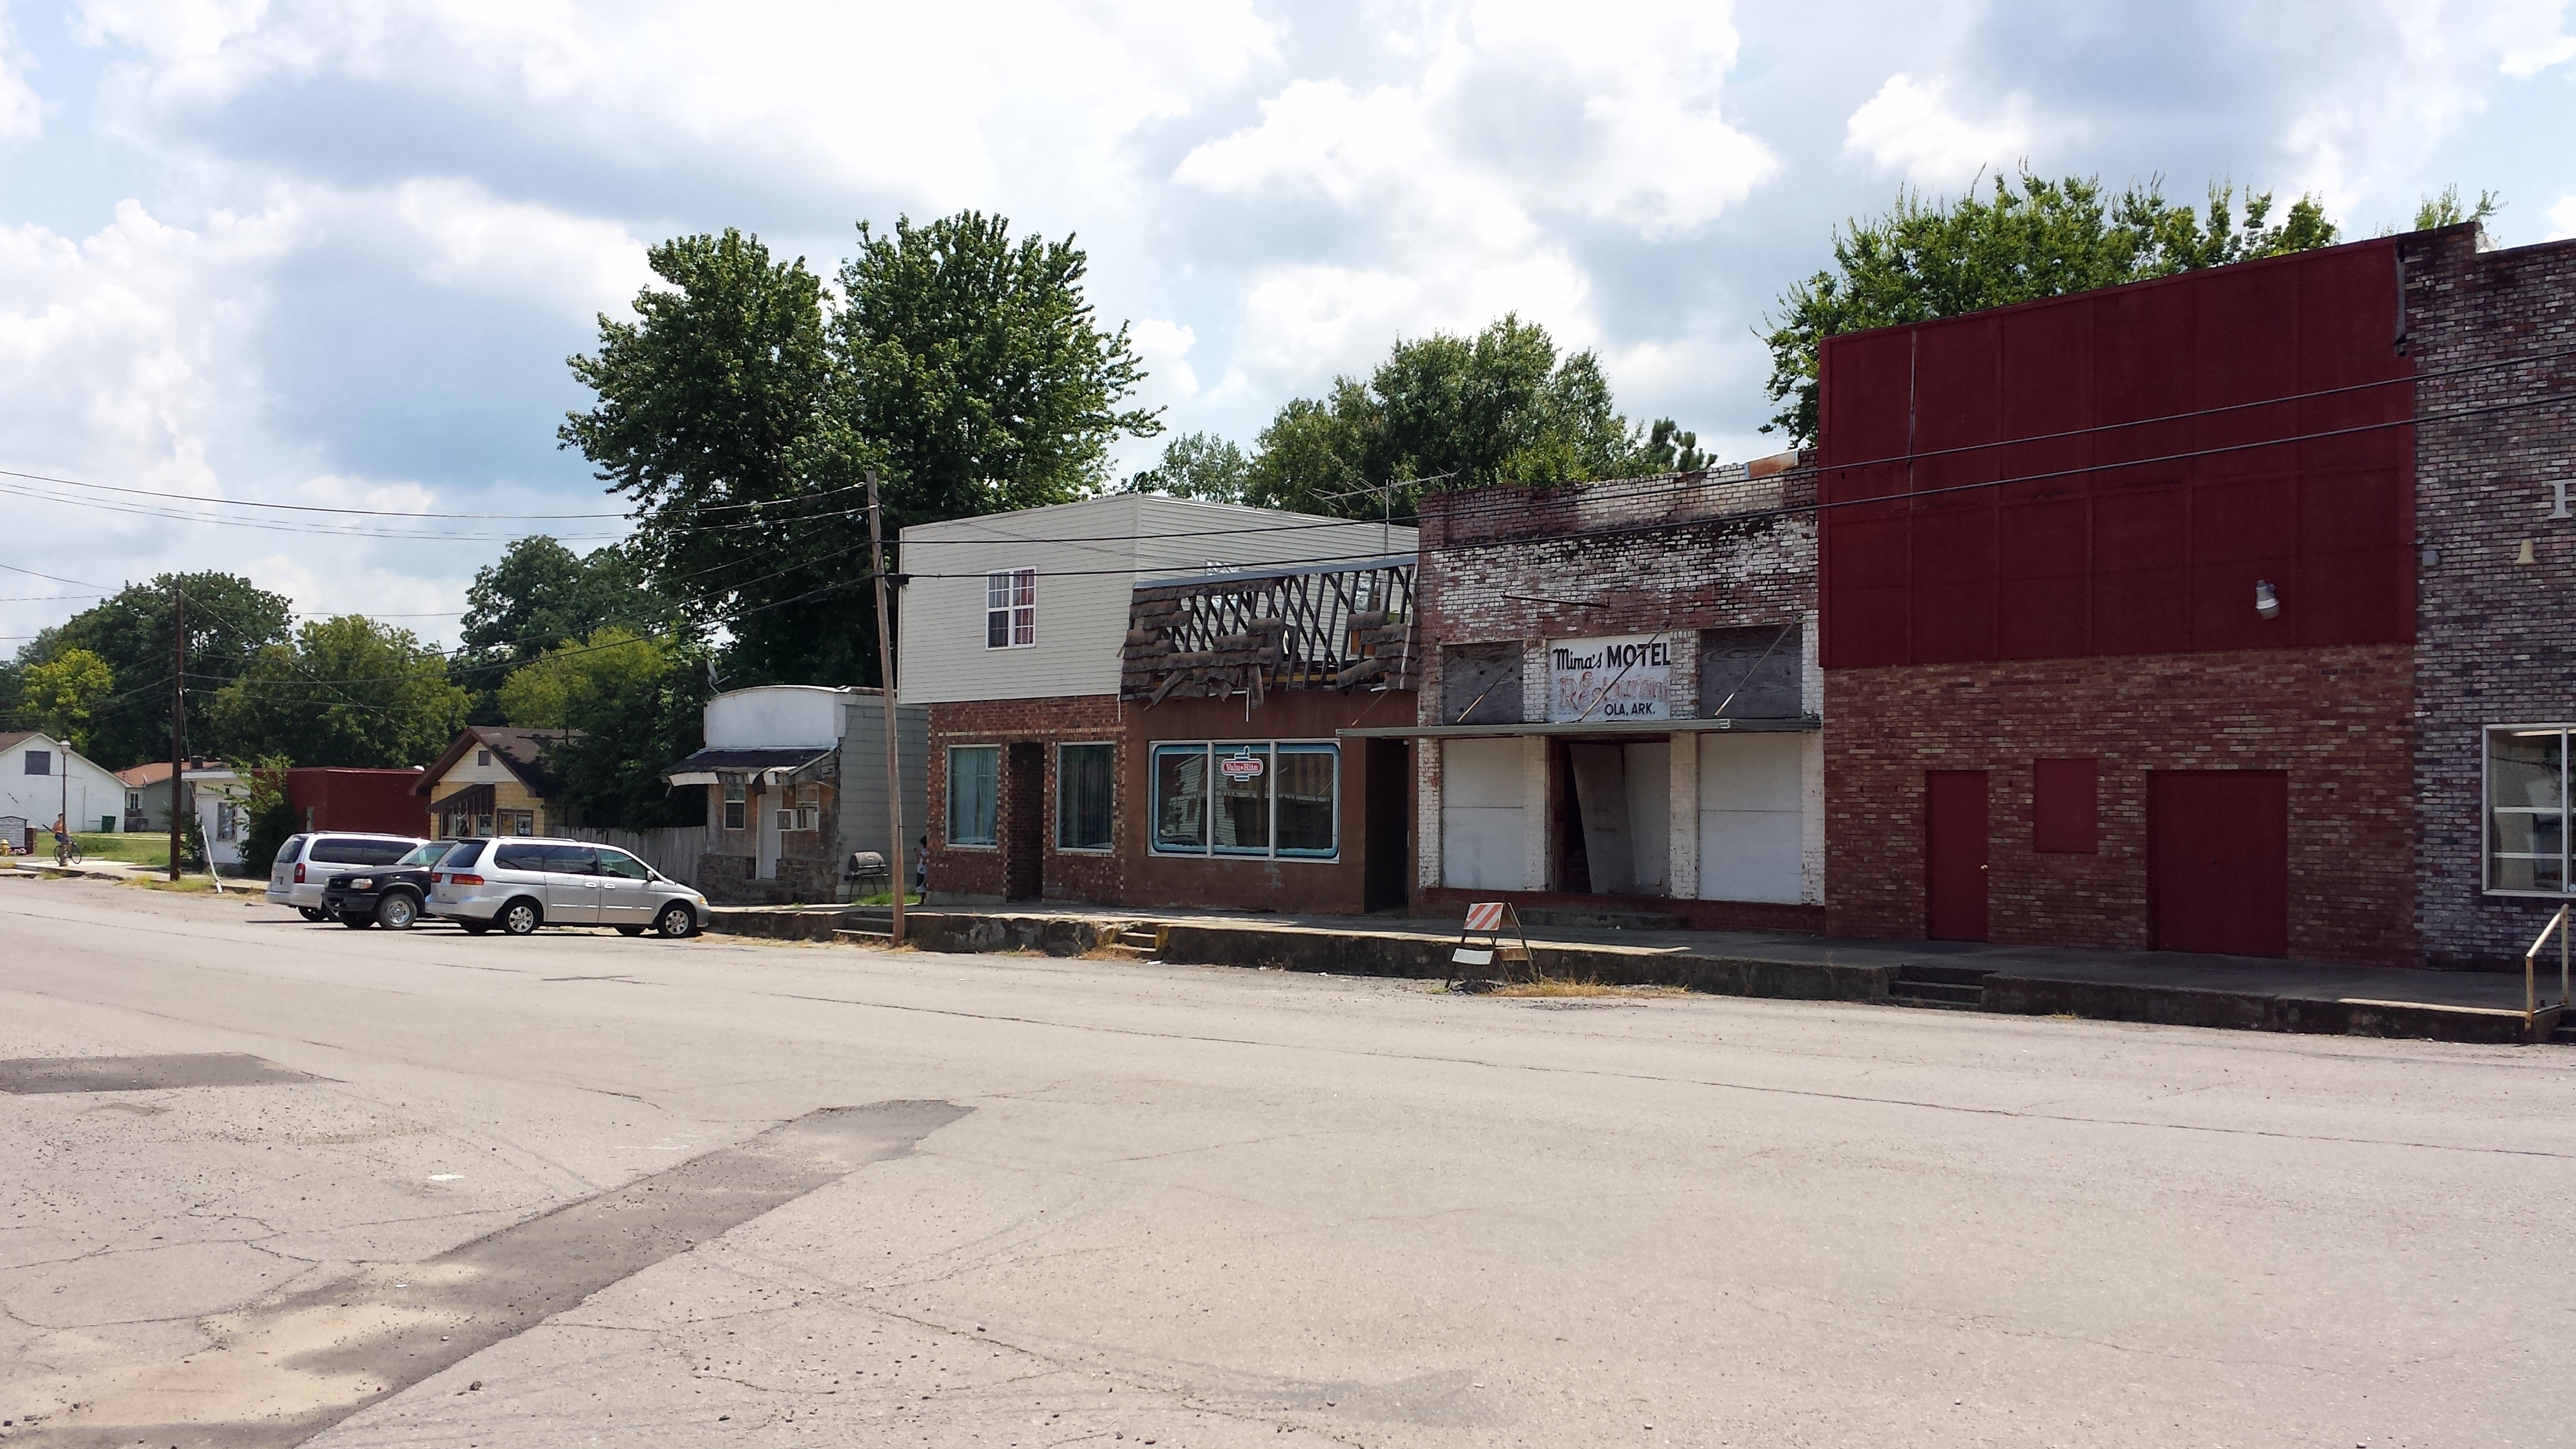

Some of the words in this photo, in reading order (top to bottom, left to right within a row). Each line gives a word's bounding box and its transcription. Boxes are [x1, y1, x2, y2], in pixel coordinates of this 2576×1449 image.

[1553, 648, 1602, 670] Mima's
[1607, 643, 1671, 668] MOTEL
[1604, 704, 1628, 716] OLA,
[1631, 703, 1655, 715] ARK.
